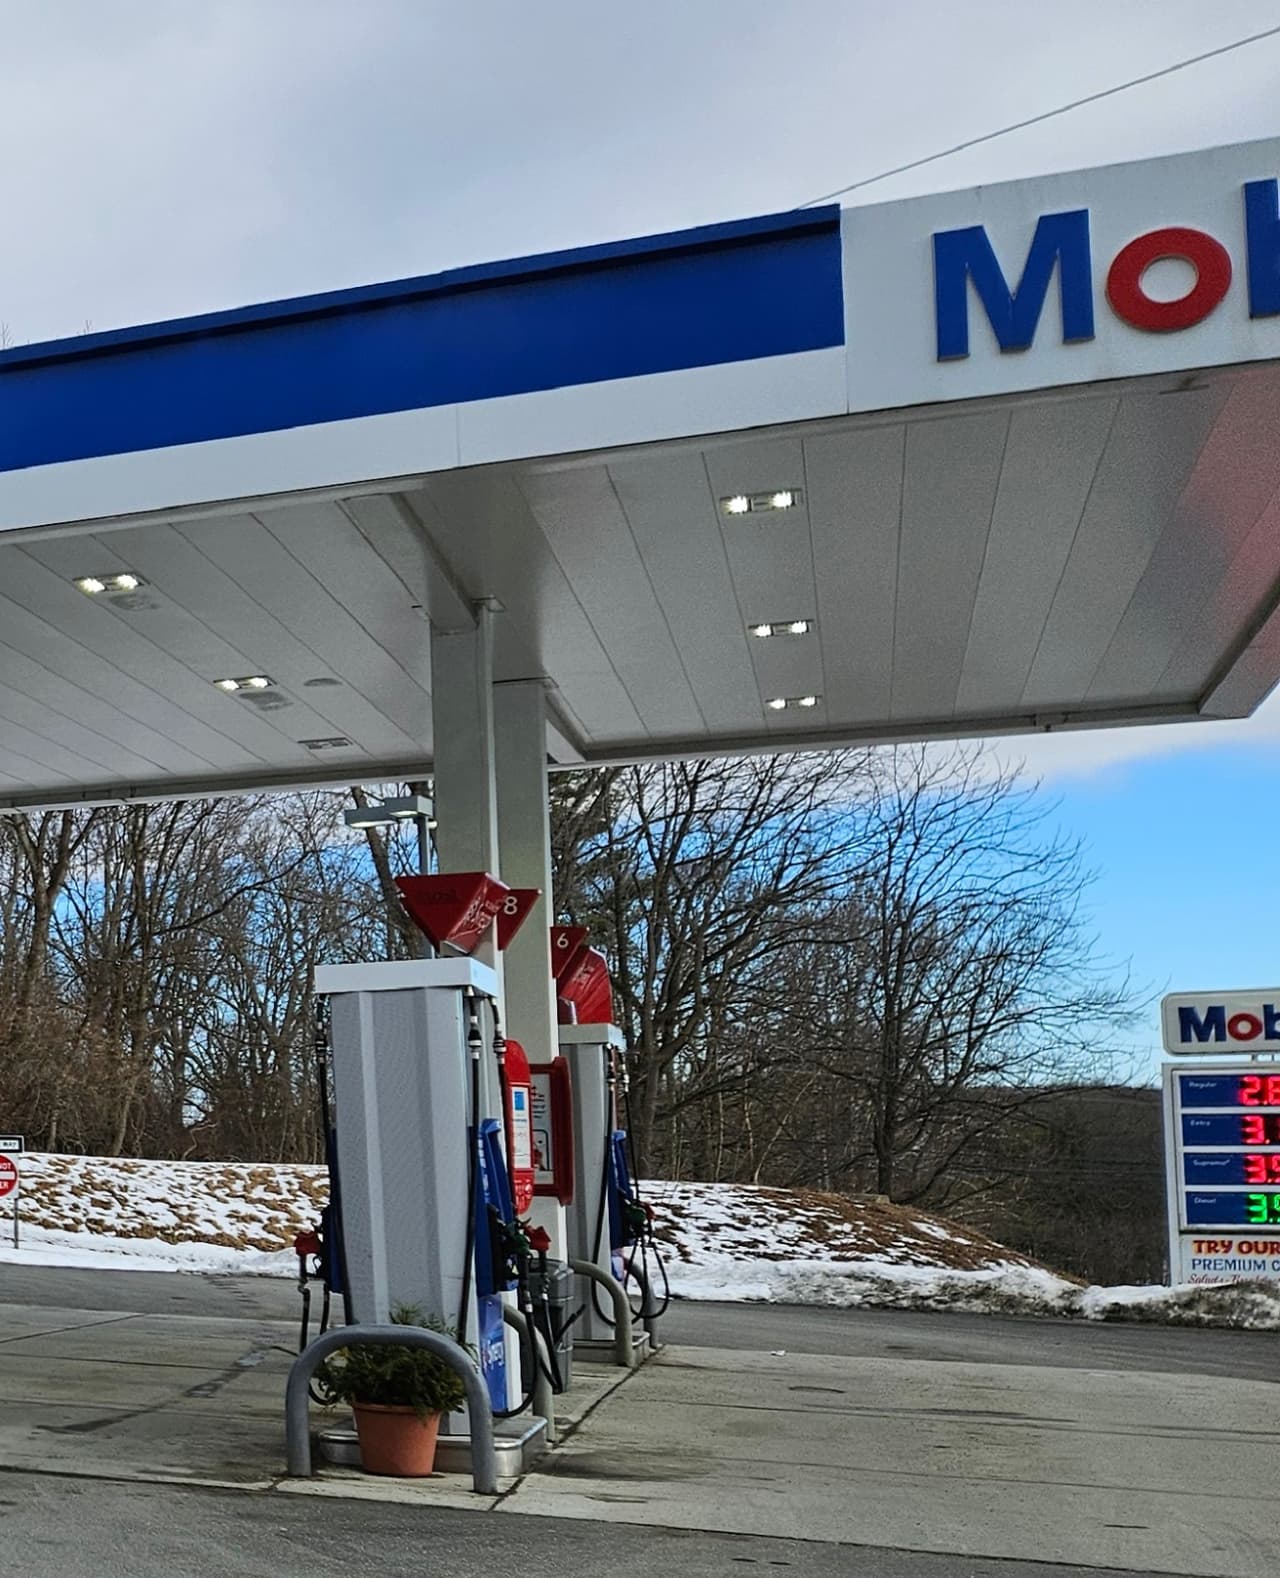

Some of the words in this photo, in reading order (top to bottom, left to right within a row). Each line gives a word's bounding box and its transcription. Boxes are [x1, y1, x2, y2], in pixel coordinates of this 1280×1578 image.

[503, 896, 518, 915] 8
[556, 933, 569, 949] 6
[1192, 1239, 1233, 1254] TRY
[1192, 1258, 1266, 1272] PREMIUM
